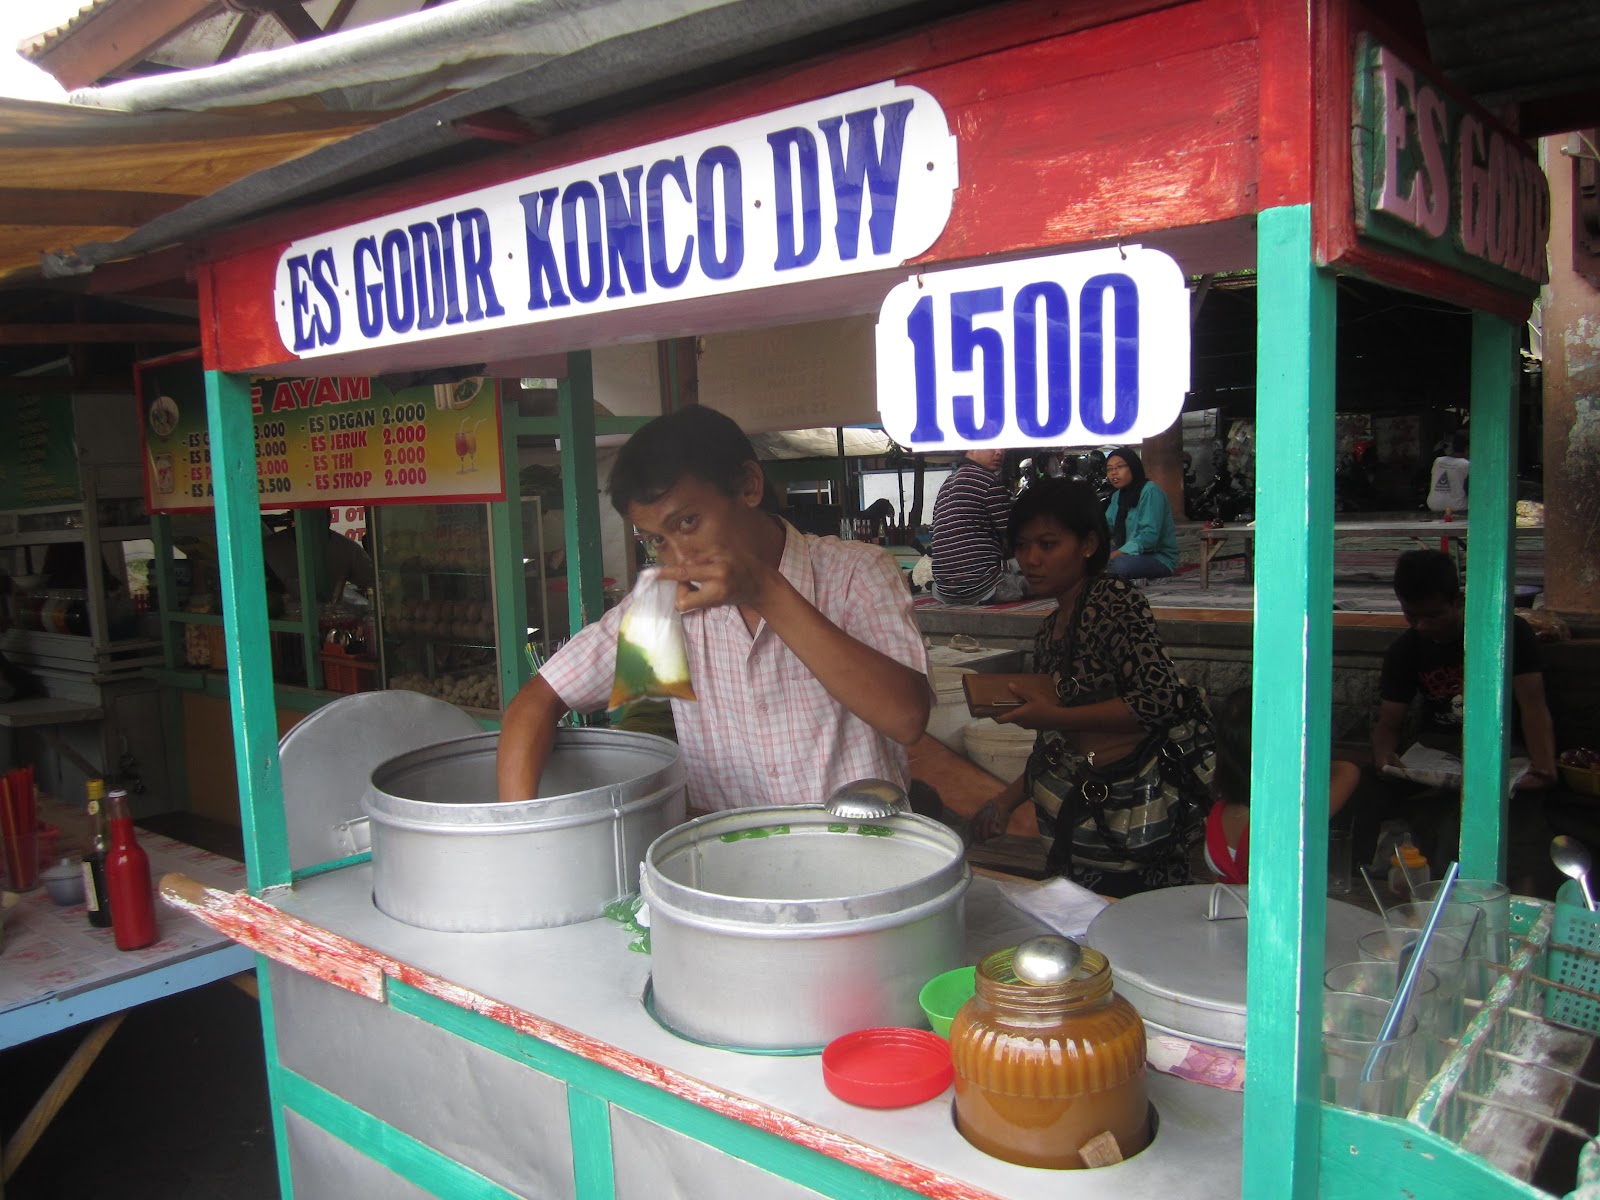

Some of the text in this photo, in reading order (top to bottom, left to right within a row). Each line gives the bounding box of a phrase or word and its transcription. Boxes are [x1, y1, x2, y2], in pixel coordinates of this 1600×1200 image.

[1372, 46, 1449, 238] ES
[286, 98, 914, 351] ES GODIR KONCO DW
[907, 272, 1139, 442] 1500
[272, 375, 371, 412] AYAM
[308, 403, 426, 433] ES DEGAN 2.000
[189, 433, 200, 447] ES
[310, 424, 426, 452] ES JERUK 2.000
[190, 450, 201, 464] ES
[313, 445, 426, 471] ES TEH 2.000
[191, 467, 203, 480] ES
[315, 467, 427, 490] ES STROP 2.000
[191, 483, 203, 497] ES
